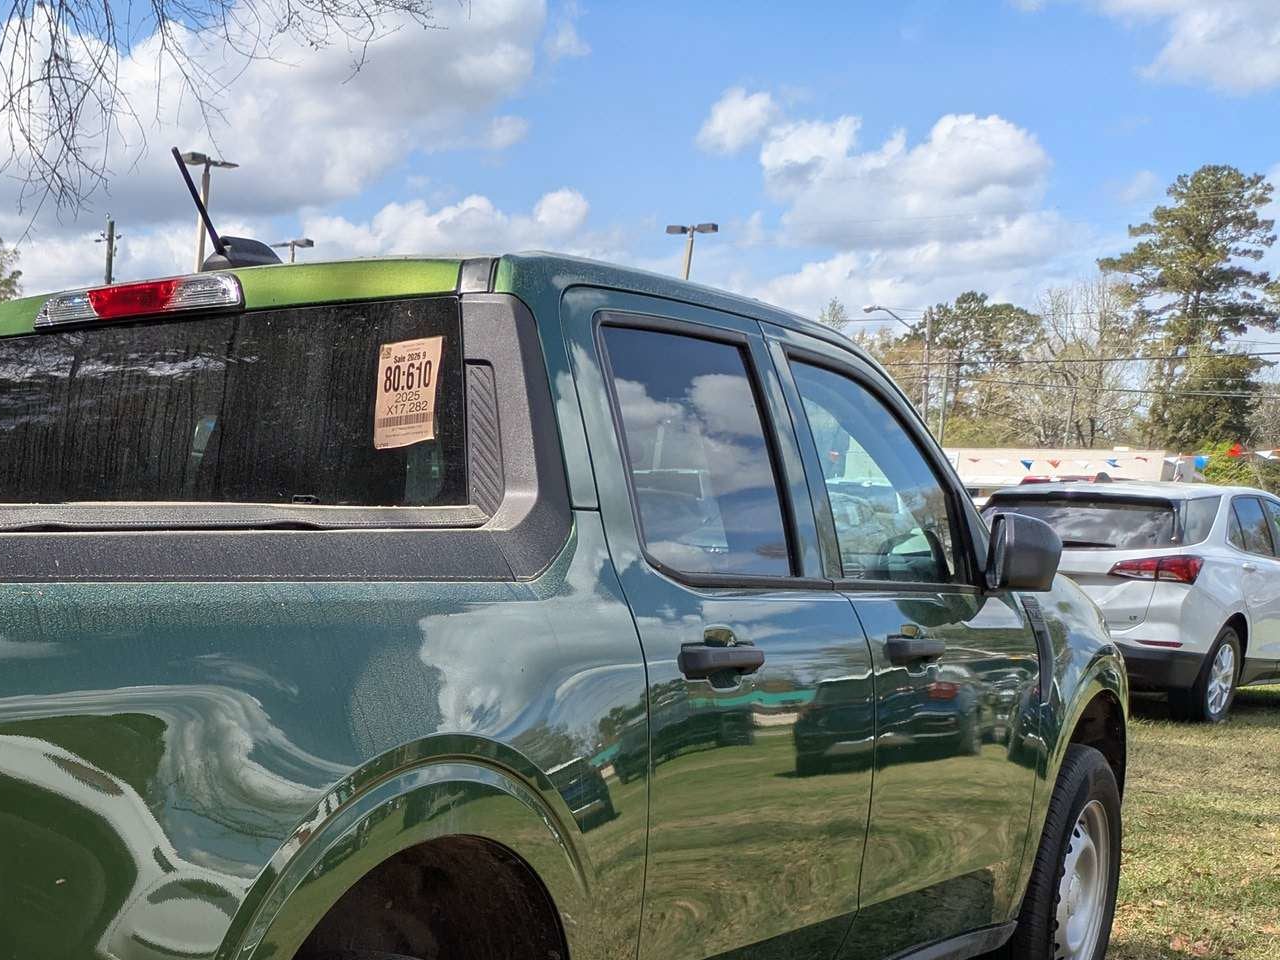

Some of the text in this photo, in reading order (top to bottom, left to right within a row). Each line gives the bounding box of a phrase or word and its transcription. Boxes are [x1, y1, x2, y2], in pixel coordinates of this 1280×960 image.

[393, 354, 406, 364] Sale
[384, 360, 432, 393] 80:610
[394, 391, 420, 403] 2025
